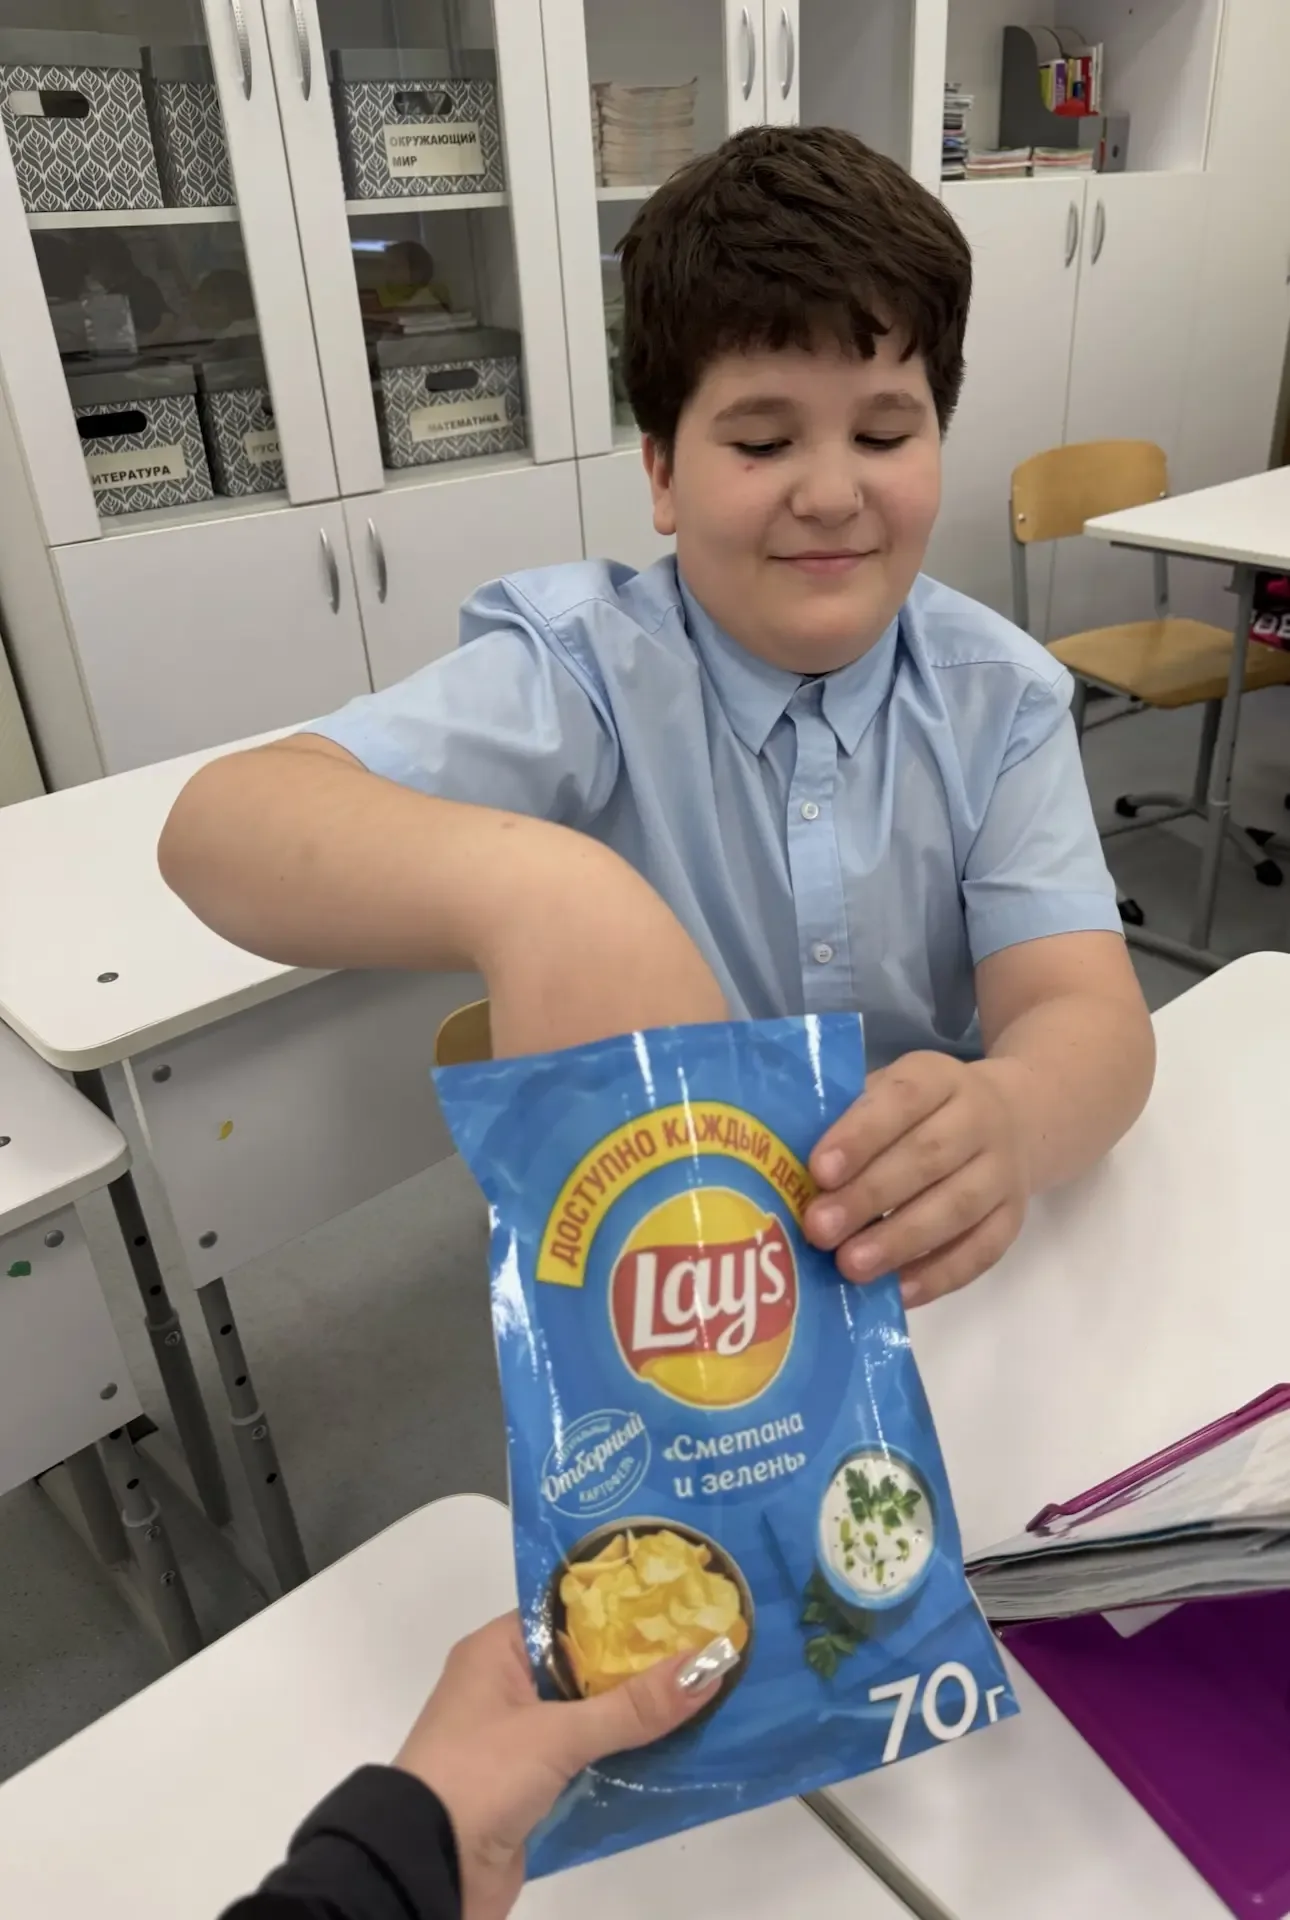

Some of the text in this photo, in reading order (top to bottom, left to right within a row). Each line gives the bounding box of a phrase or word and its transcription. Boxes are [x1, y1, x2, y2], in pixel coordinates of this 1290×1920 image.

[389, 131, 477, 147] ОКРУЖАЮЩИЙ
[392, 155, 418, 167] МИР
[91, 465, 171, 486] ИТЕРАТУРА
[551, 1112, 813, 1268] ДОСТУПНО КАЖДЫЙ ДЕН
[632, 1229, 786, 1356] Lay's
[541, 1412, 646, 1503] Отборный
[673, 1476, 694, 1499] и
